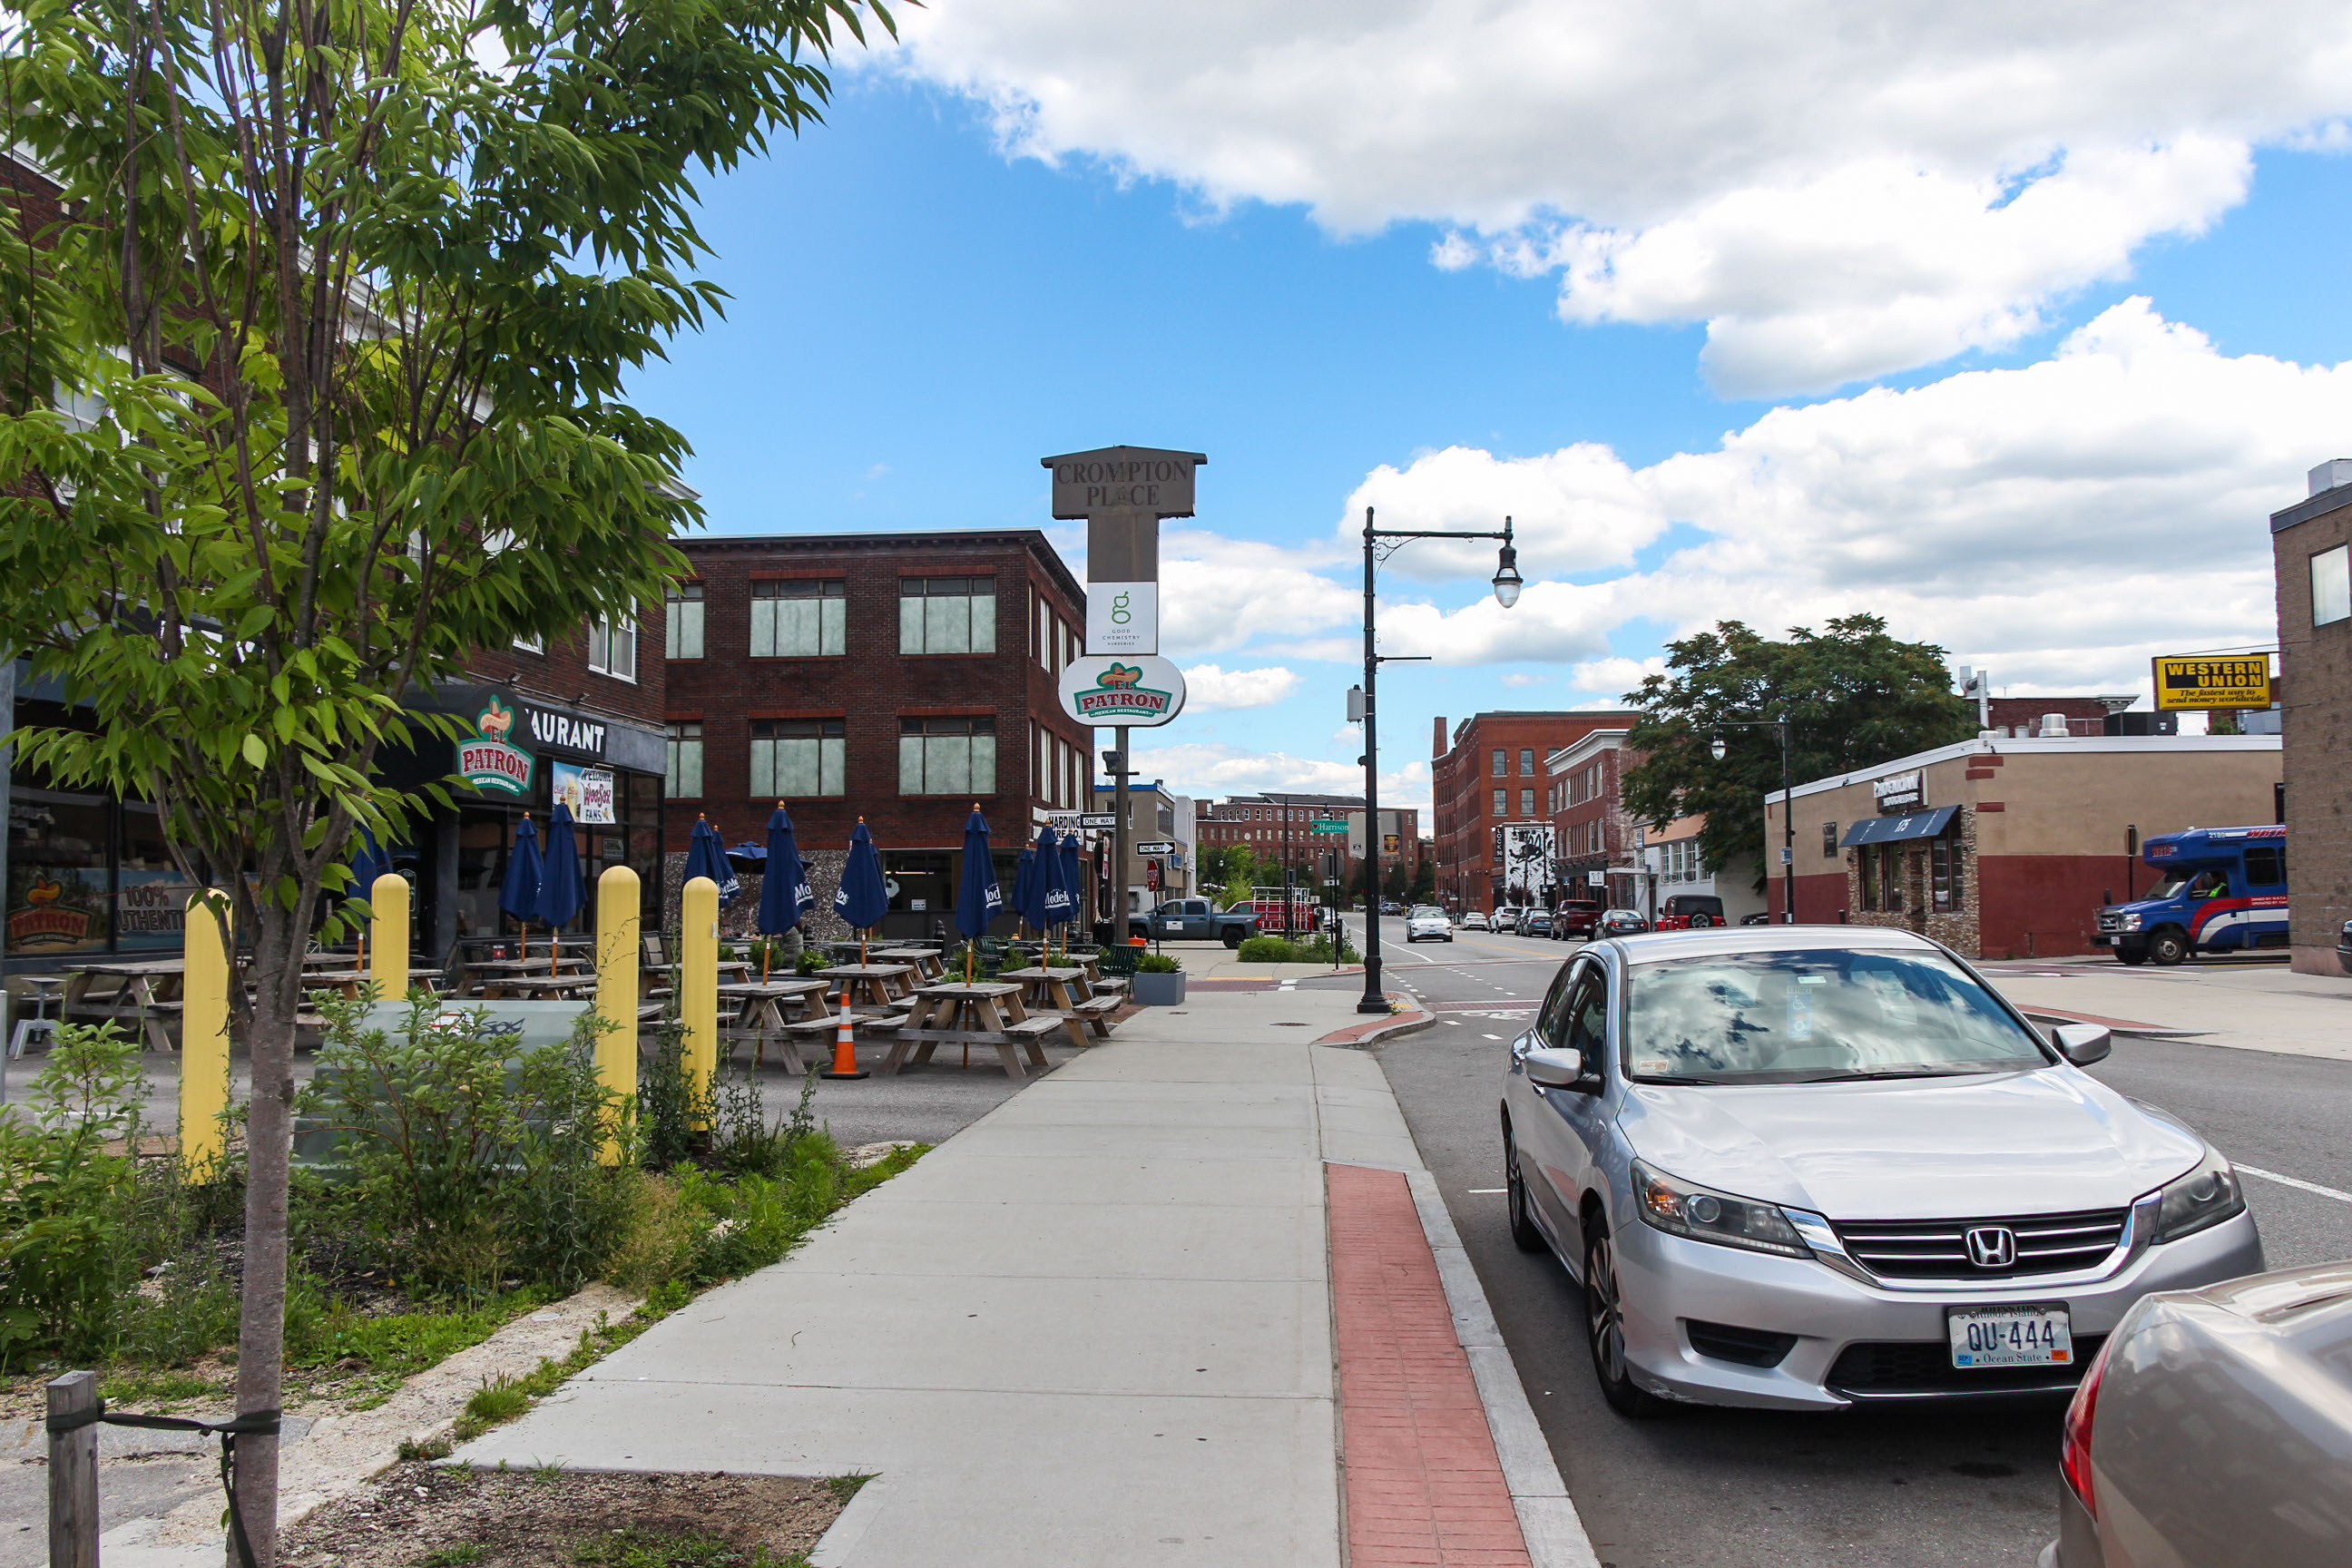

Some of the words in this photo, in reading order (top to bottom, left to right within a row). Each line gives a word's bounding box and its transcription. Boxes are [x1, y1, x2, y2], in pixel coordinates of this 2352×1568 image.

[1057, 461, 1188, 484] CROMPTON
[2167, 662, 2261, 676] WESTERN
[1114, 680, 1133, 691] EL
[2198, 674, 2262, 687] UNION
[2189, 697, 2216, 705] money
[2219, 695, 2267, 703] worldwide.
[2197, 689, 2225, 698] fastest
[1081, 691, 1164, 710] PATRÓN
[490, 727, 505, 745] EL
[524, 708, 604, 753] AURANT
[462, 748, 529, 783] PATRÓN
[582, 769, 612, 782] WELCOME
[491, 778, 516, 791] RESTAURANT
[585, 809, 603, 822] FANS
[1049, 817, 1080, 828] HARDING
[1318, 823, 1348, 831] Harrison
[1894, 818, 1913, 833] 175
[1147, 869, 1159, 882] STOP
[124, 886, 169, 906] 100%
[117, 909, 184, 931] UTHENTI
[1967, 1319, 2054, 1352] QU-444
[1983, 1353, 2014, 1363] Ocean
[2016, 1352, 2042, 1362] State
